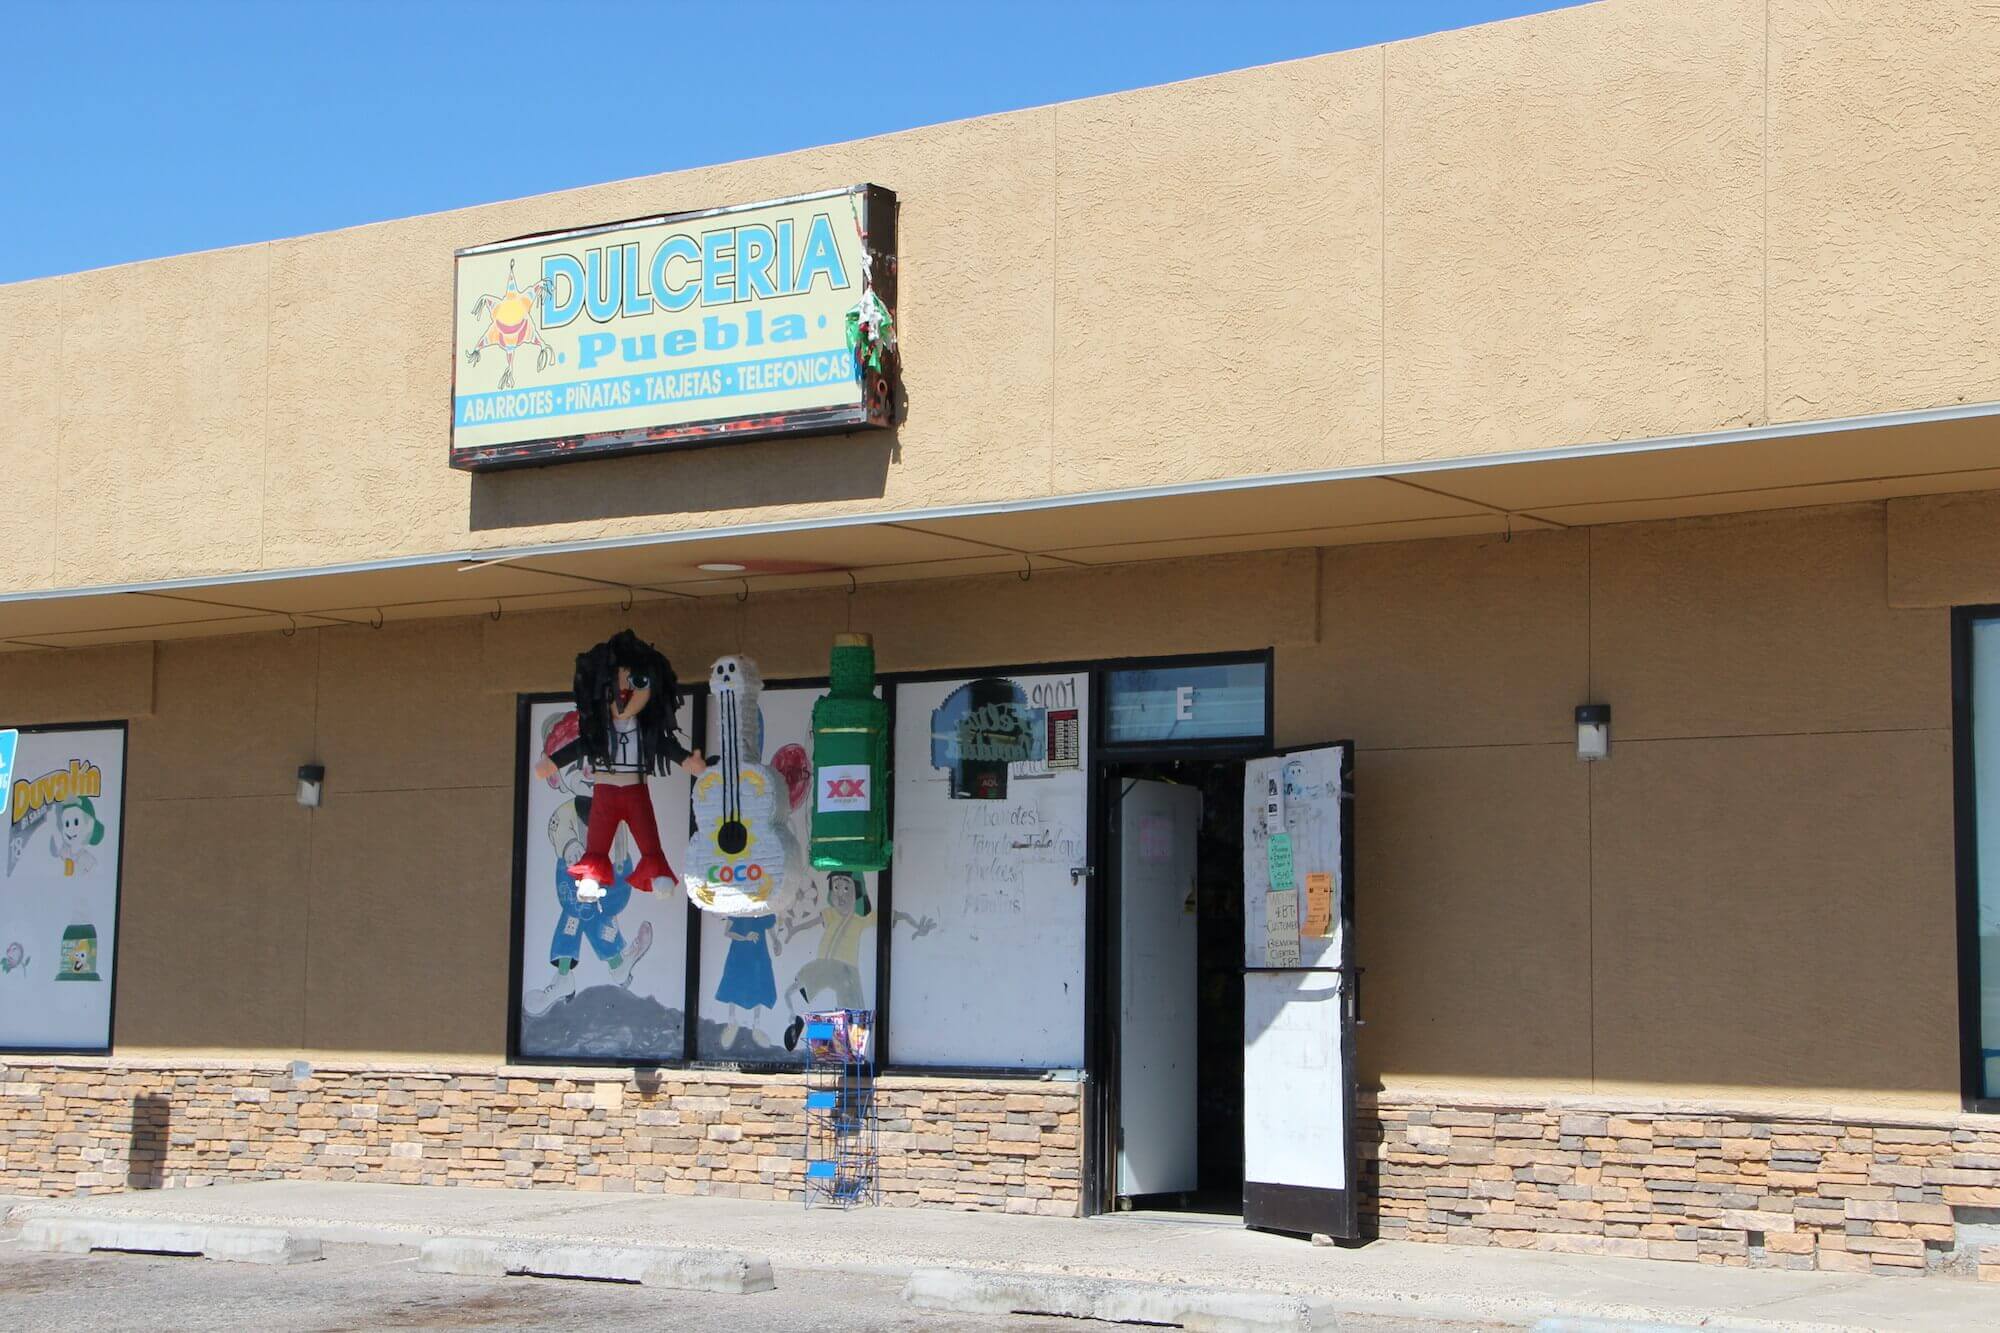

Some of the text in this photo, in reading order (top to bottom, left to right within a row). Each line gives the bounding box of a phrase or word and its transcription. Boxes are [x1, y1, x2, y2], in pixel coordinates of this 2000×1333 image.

[541, 213, 850, 330] DULCERIA
[578, 309, 807, 369] Puebla
[463, 355, 850, 423] ABARROTES PIÑATAS TARJETAS TELEFONICAS
[1176, 686, 1194, 721] E
[827, 779, 866, 798] XX
[707, 863, 762, 884] COCO
